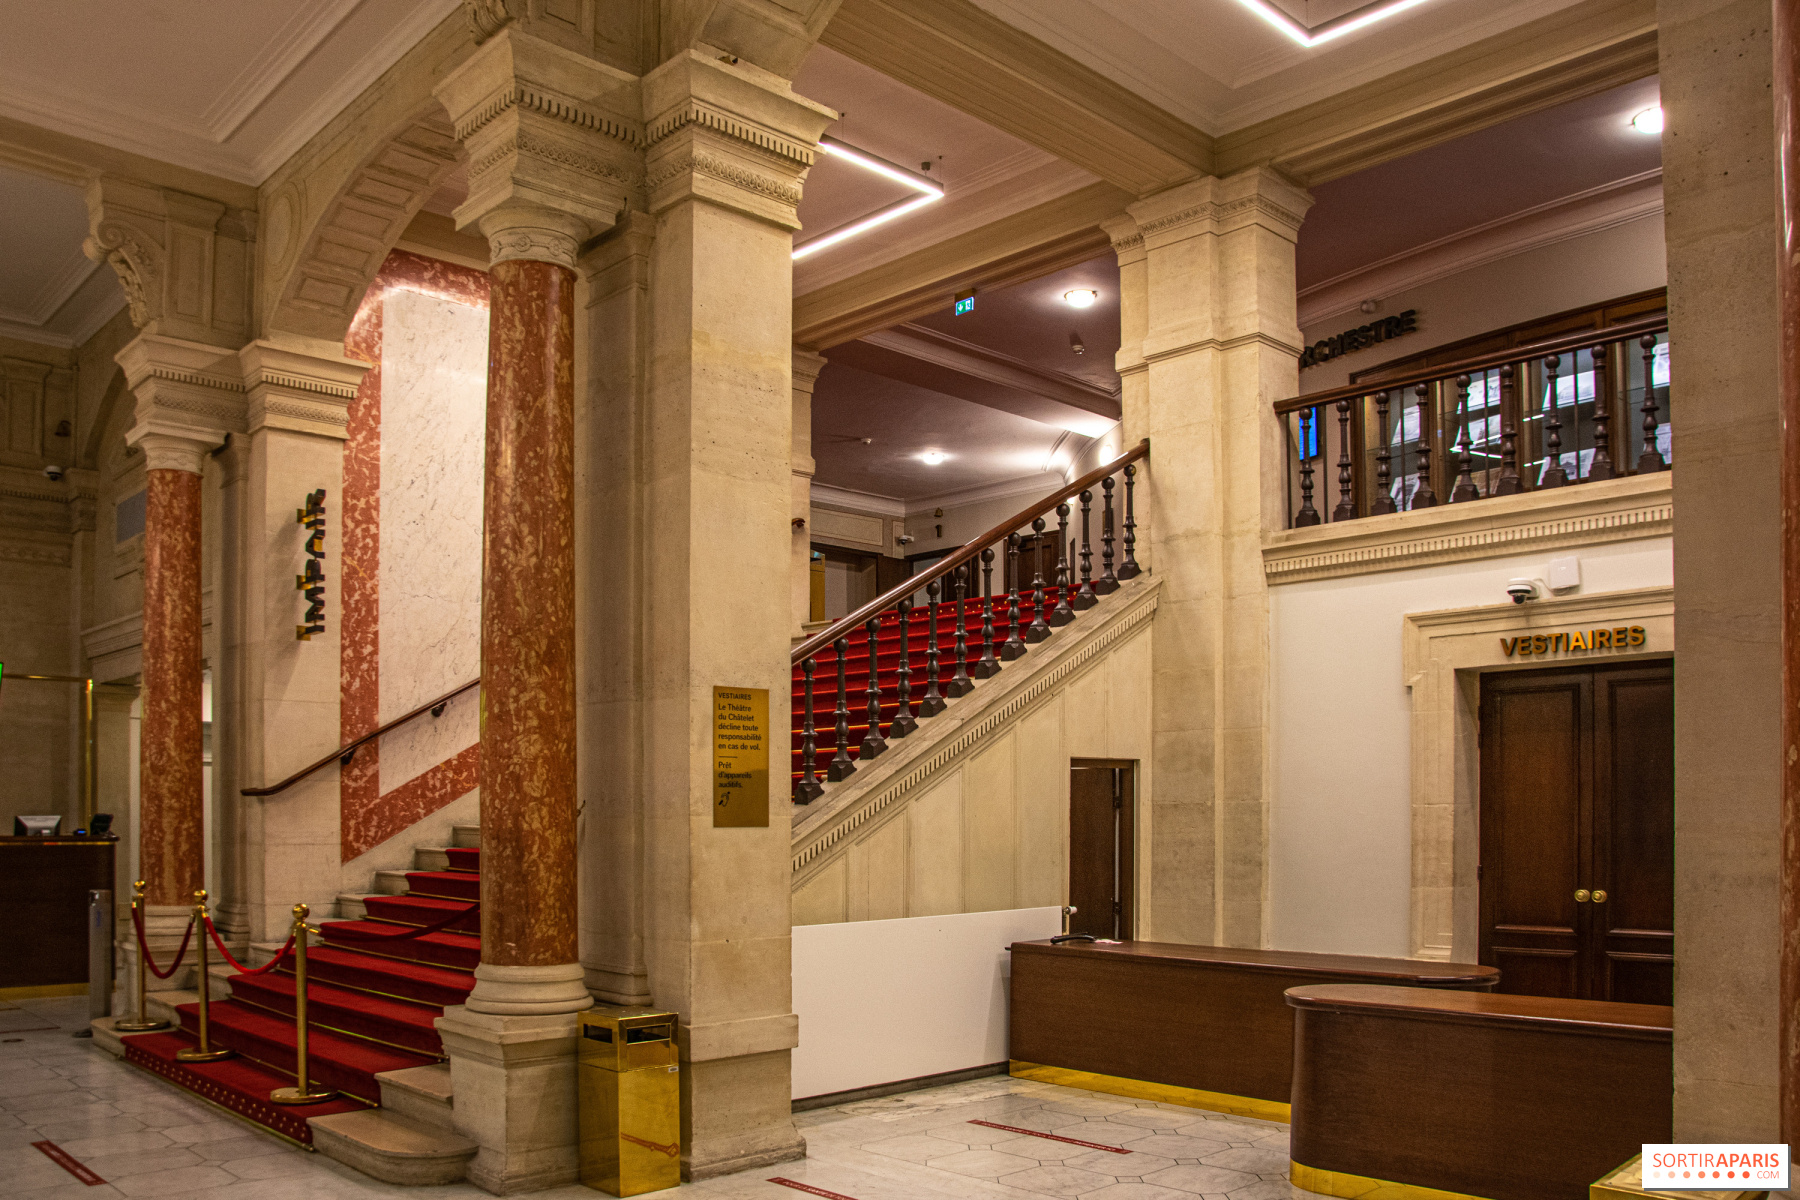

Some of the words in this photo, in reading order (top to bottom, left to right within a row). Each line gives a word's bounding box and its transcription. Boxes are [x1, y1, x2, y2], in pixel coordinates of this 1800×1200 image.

[1298, 309, 1416, 370] RCHESTRE
[305, 488, 326, 635] IMPAIR
[1500, 625, 1645, 656] VESTIAIRES
[718, 692, 752, 700] VESTIAIRES
[728, 703, 752, 712] Théâtre
[728, 713, 754, 721] Châtelet
[750, 743, 761, 751] vol.
[718, 761, 732, 769] Prêt
